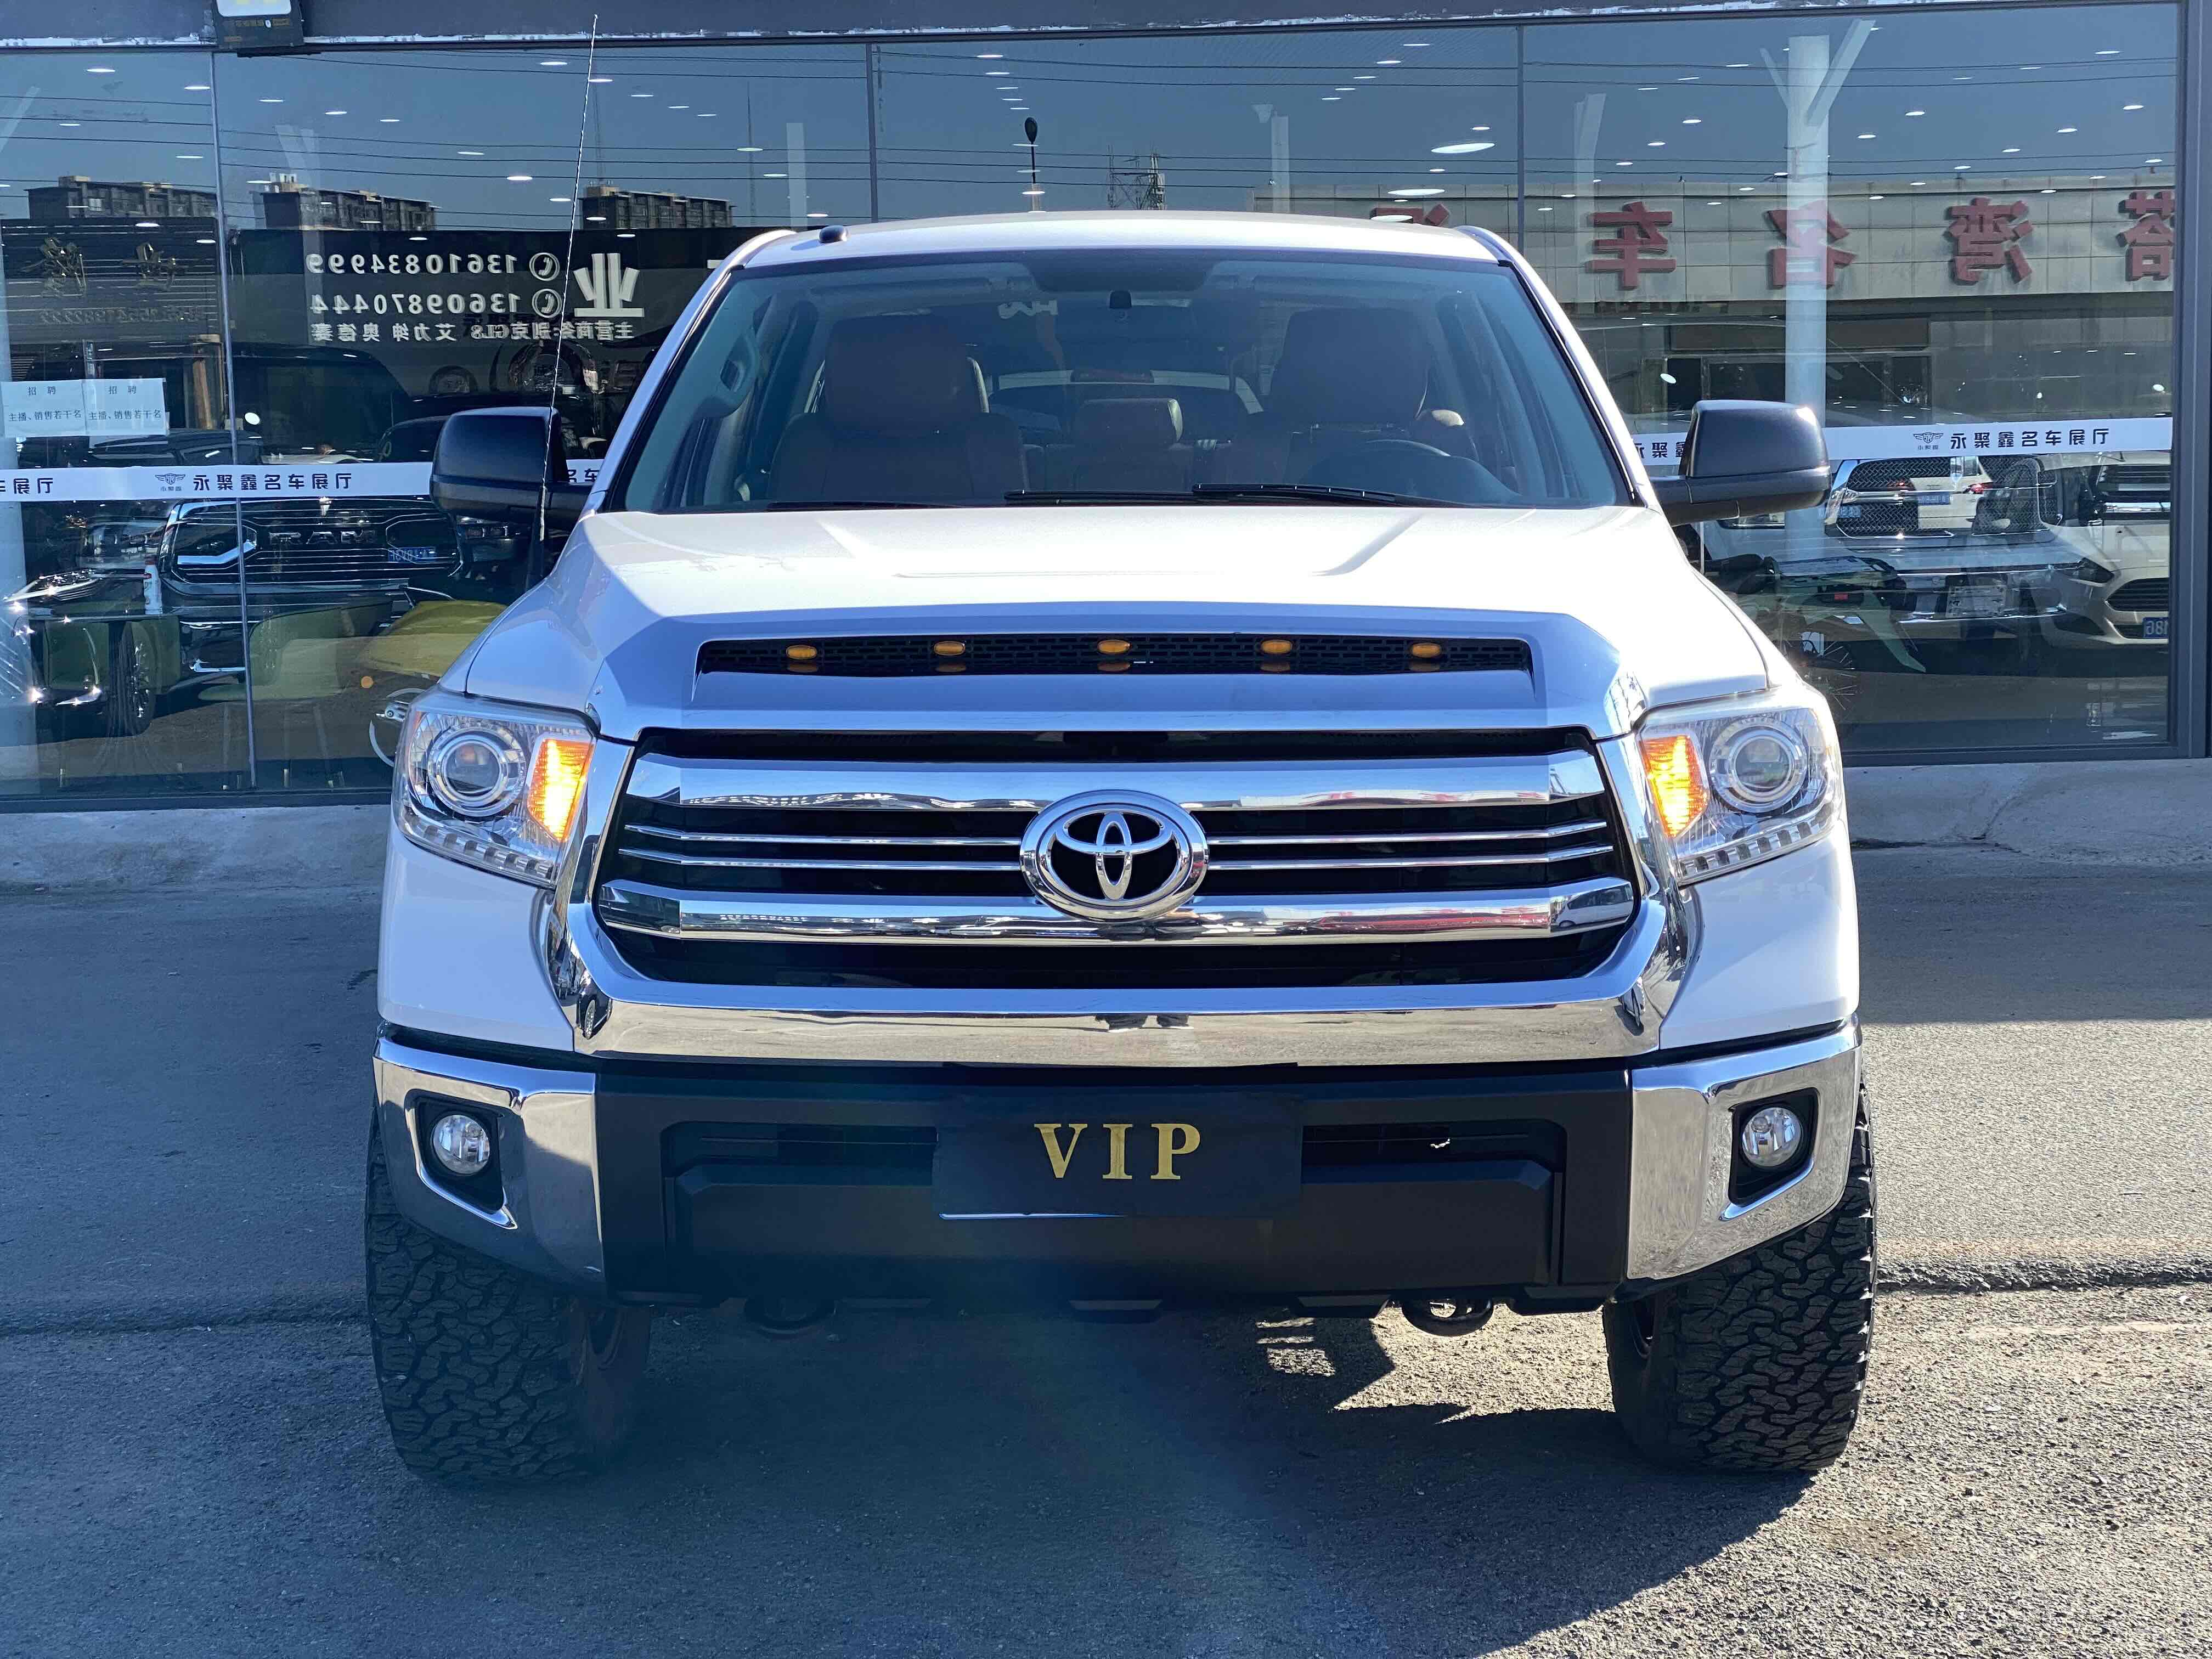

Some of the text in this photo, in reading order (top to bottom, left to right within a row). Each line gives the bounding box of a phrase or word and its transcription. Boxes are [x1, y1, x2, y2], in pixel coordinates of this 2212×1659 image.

[1950, 428, 2109, 449] 永聚鑫名车展厅
[193, 473, 352, 491] 永聚鑫名车展厅
[1034, 1123, 1201, 1180] VIP
